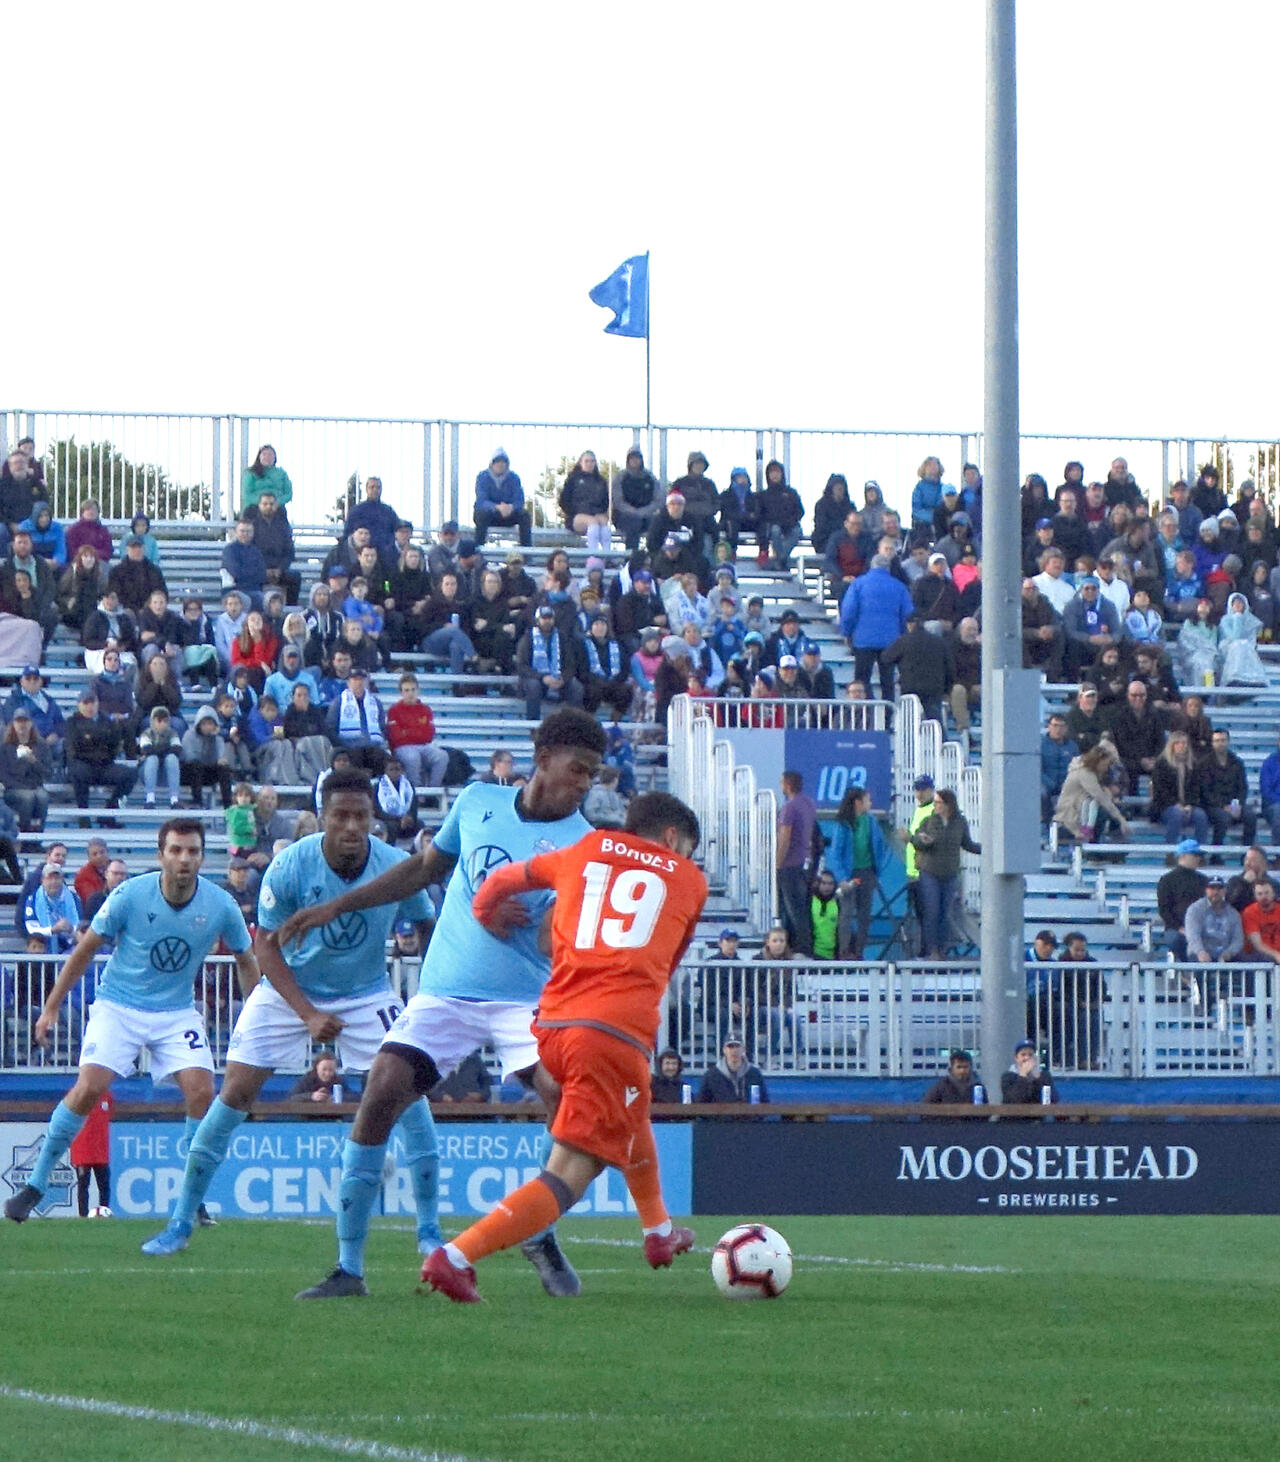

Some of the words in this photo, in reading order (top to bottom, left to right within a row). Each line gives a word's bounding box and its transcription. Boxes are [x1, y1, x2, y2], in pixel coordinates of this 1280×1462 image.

[817, 765, 868, 801] 103
[574, 861, 668, 950] 19
[184, 1029, 204, 1050] 2
[118, 1136, 168, 1160] THE
[176, 1135, 290, 1160] CIAL
[296, 1135, 345, 1160] HFX
[896, 1145, 1199, 1180] MOOSEHEAD
[116, 1166, 222, 1215] CP
[233, 1166, 455, 1215] CENRE
[466, 1166, 639, 1215] CIL
[997, 1193, 1101, 1207] BREWERIES
